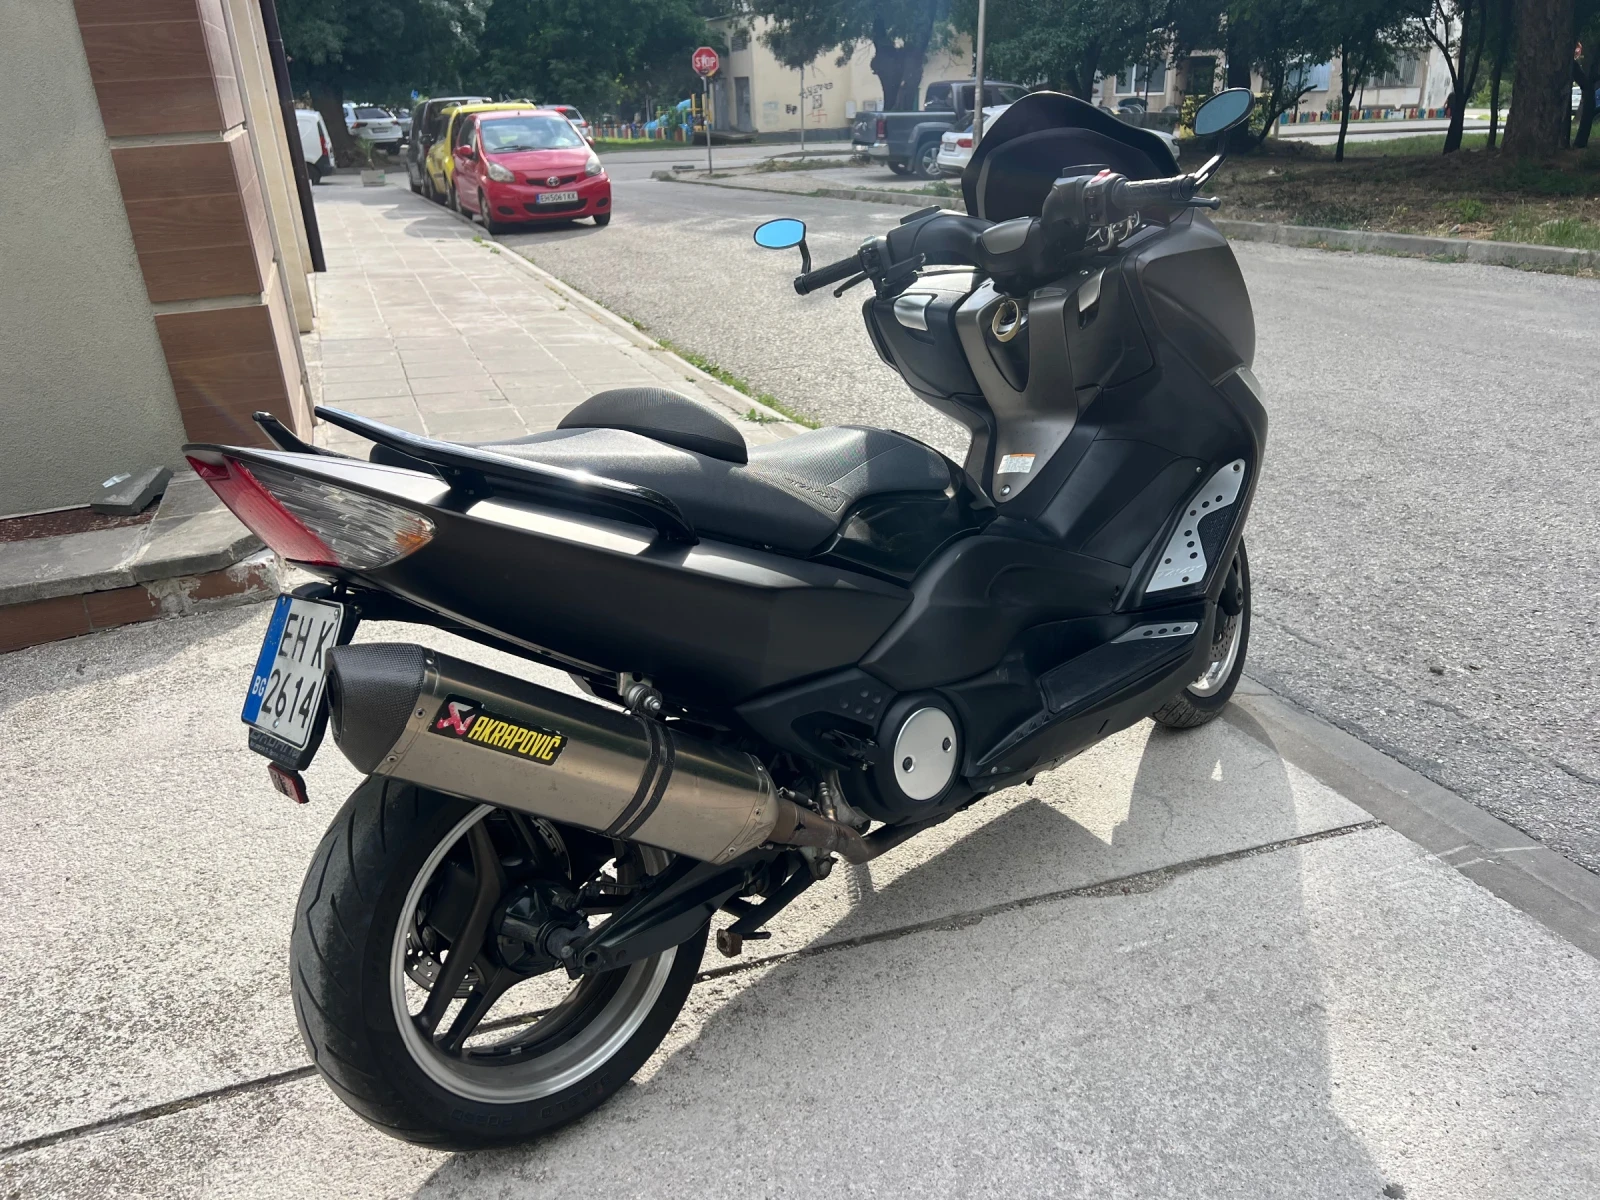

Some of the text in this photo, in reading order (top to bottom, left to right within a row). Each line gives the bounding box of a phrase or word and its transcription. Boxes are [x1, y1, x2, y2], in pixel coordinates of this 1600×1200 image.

[695, 56, 716, 67] STOP
[278, 613, 335, 669] EH K
[252, 675, 267, 697] BG
[261, 668, 317, 729] 2614
